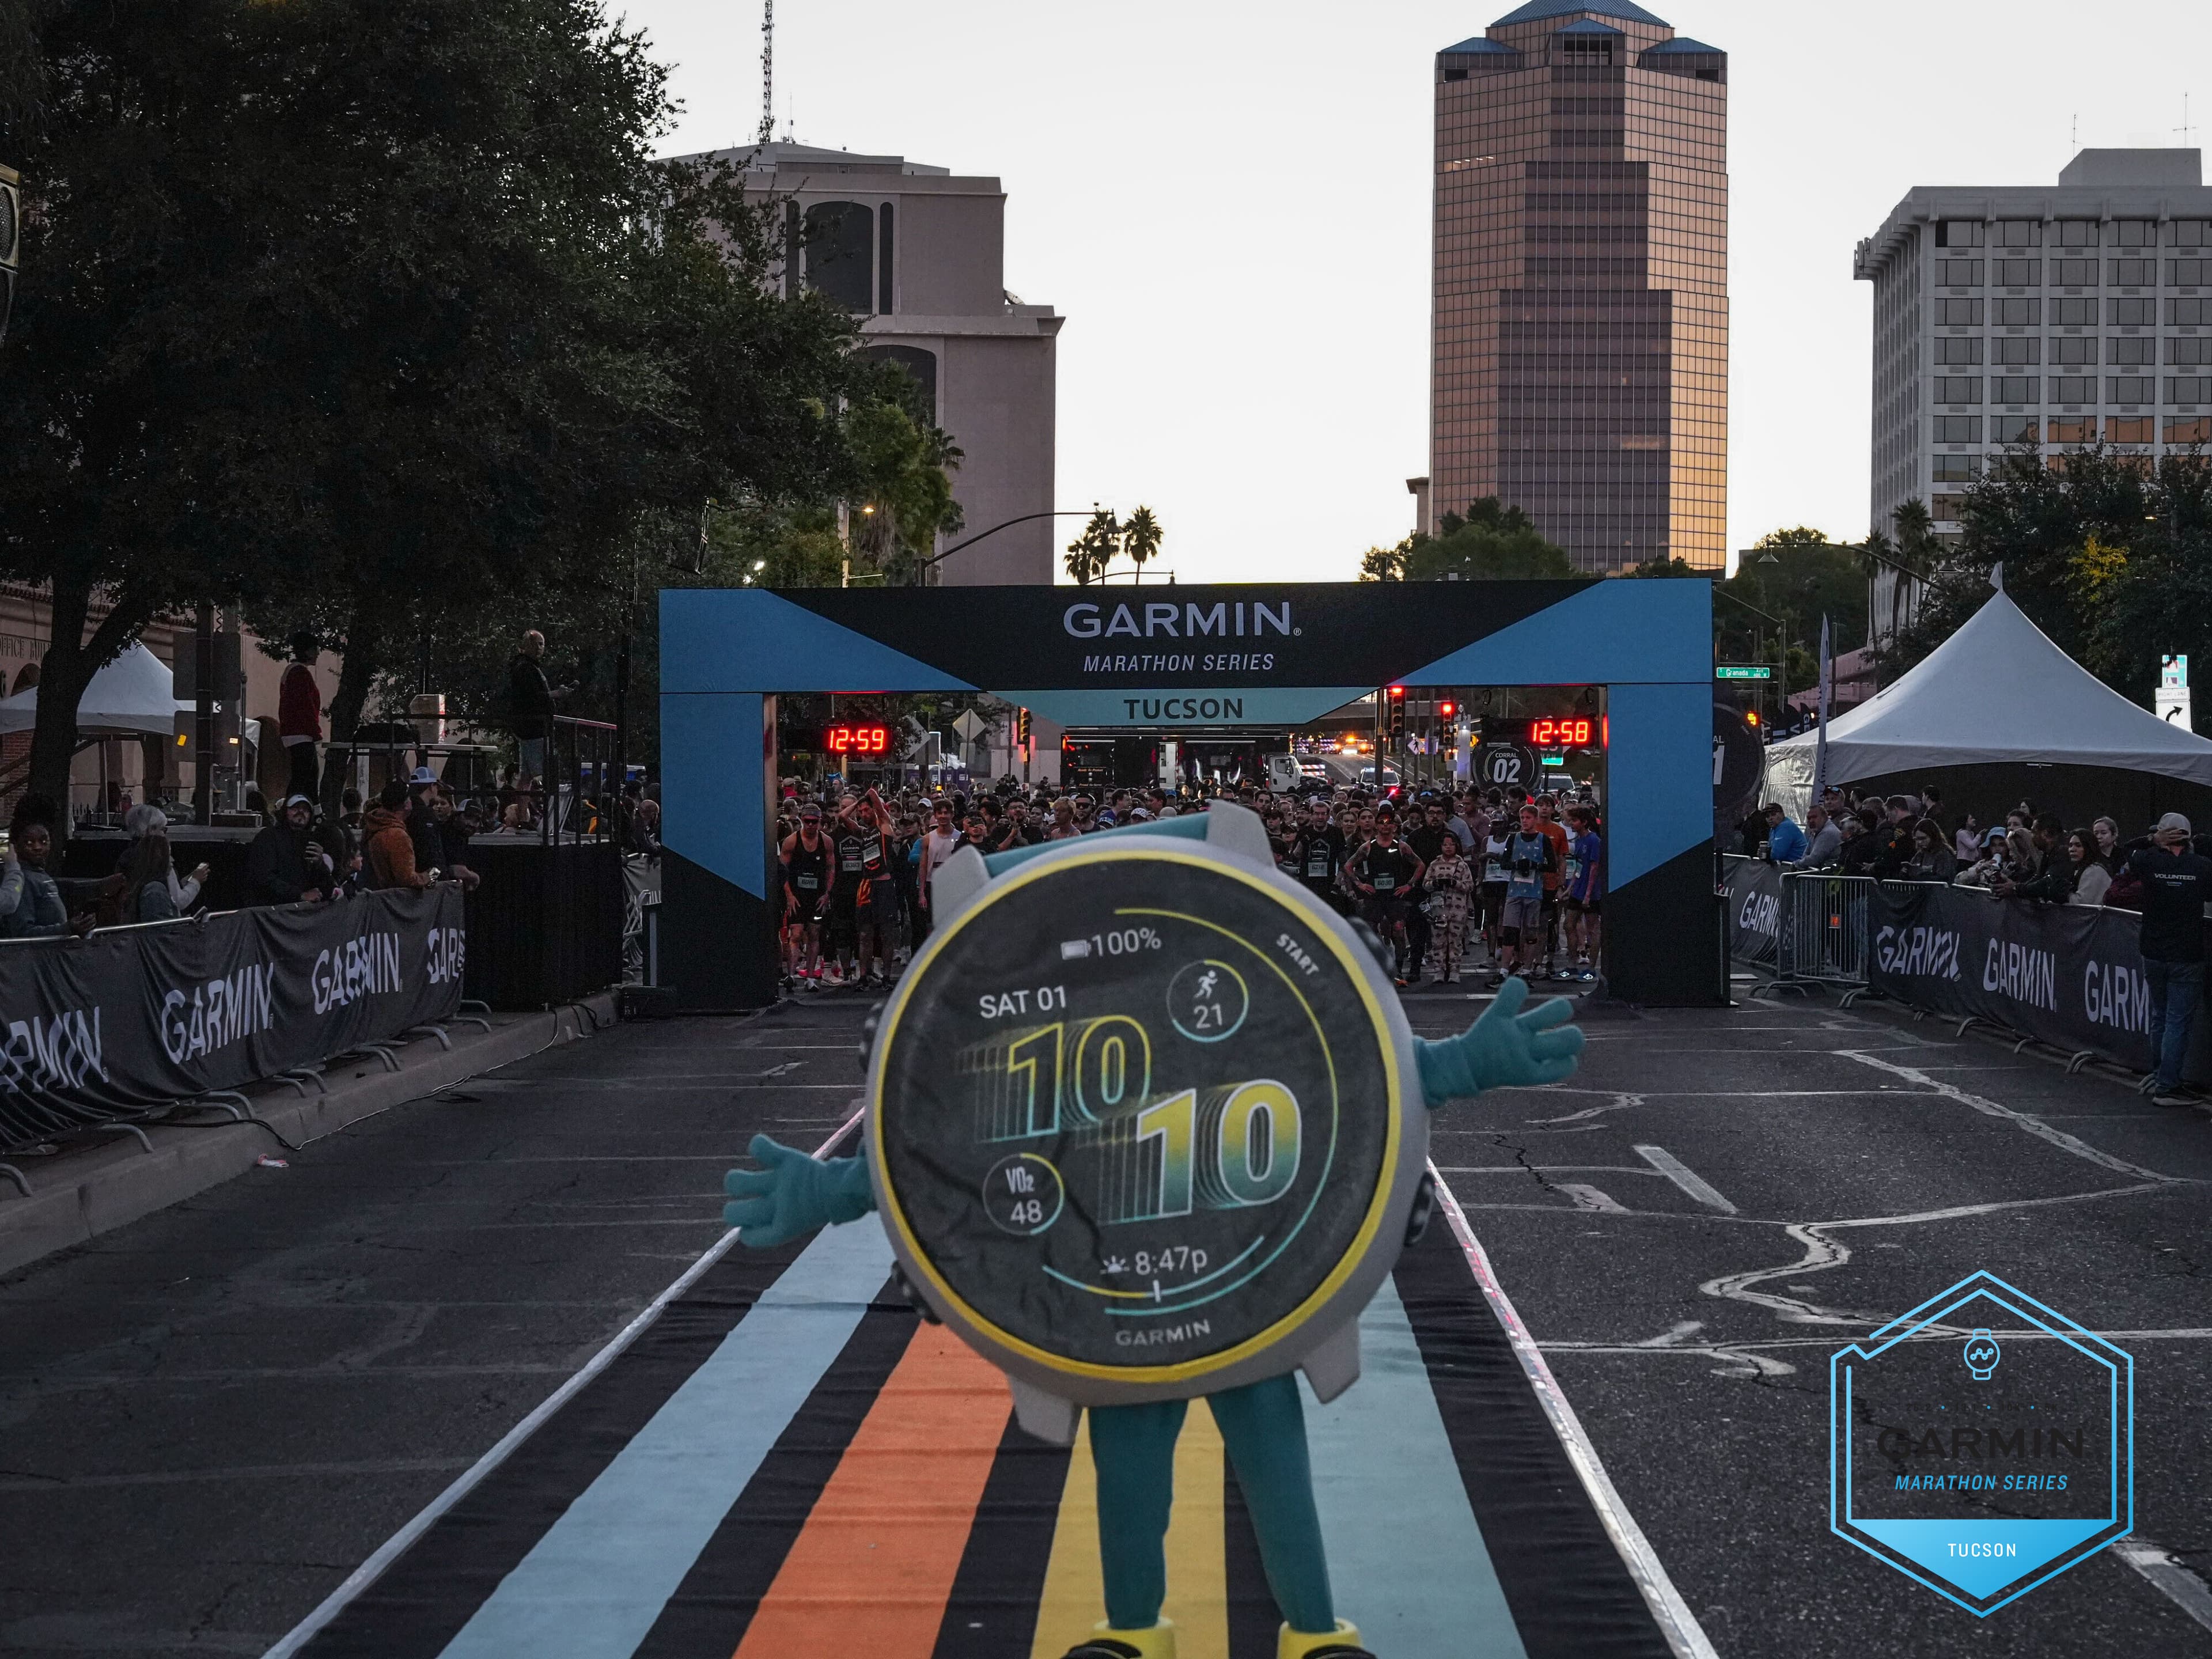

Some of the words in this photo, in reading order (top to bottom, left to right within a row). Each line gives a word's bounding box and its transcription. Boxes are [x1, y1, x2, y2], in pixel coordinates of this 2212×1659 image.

[1084, 654, 1195, 672] MARATHON
[1203, 653, 1275, 671] SERIES
[1726, 668, 1749, 677] Granada
[1123, 698, 1243, 720] TUCSON
[1493, 758, 1521, 783] 02
[2154, 873, 2196, 881] VOLUNTEER
[1092, 927, 1162, 958] 100%
[1275, 933, 1320, 977] START
[1983, 937, 2055, 1011] GARMIN
[161, 962, 274, 1065] GARMIN
[979, 990, 1030, 1019] SAT
[1037, 986, 1067, 1012] 01
[1194, 1004, 1223, 1029] 21
[1007, 1014, 1152, 1138] 10
[1137, 1079, 1302, 1218] 10
[1010, 1199, 1043, 1225] 48
[1135, 1245, 1207, 1275] 8:47p
[1115, 1319, 1211, 1347] GARMIN
